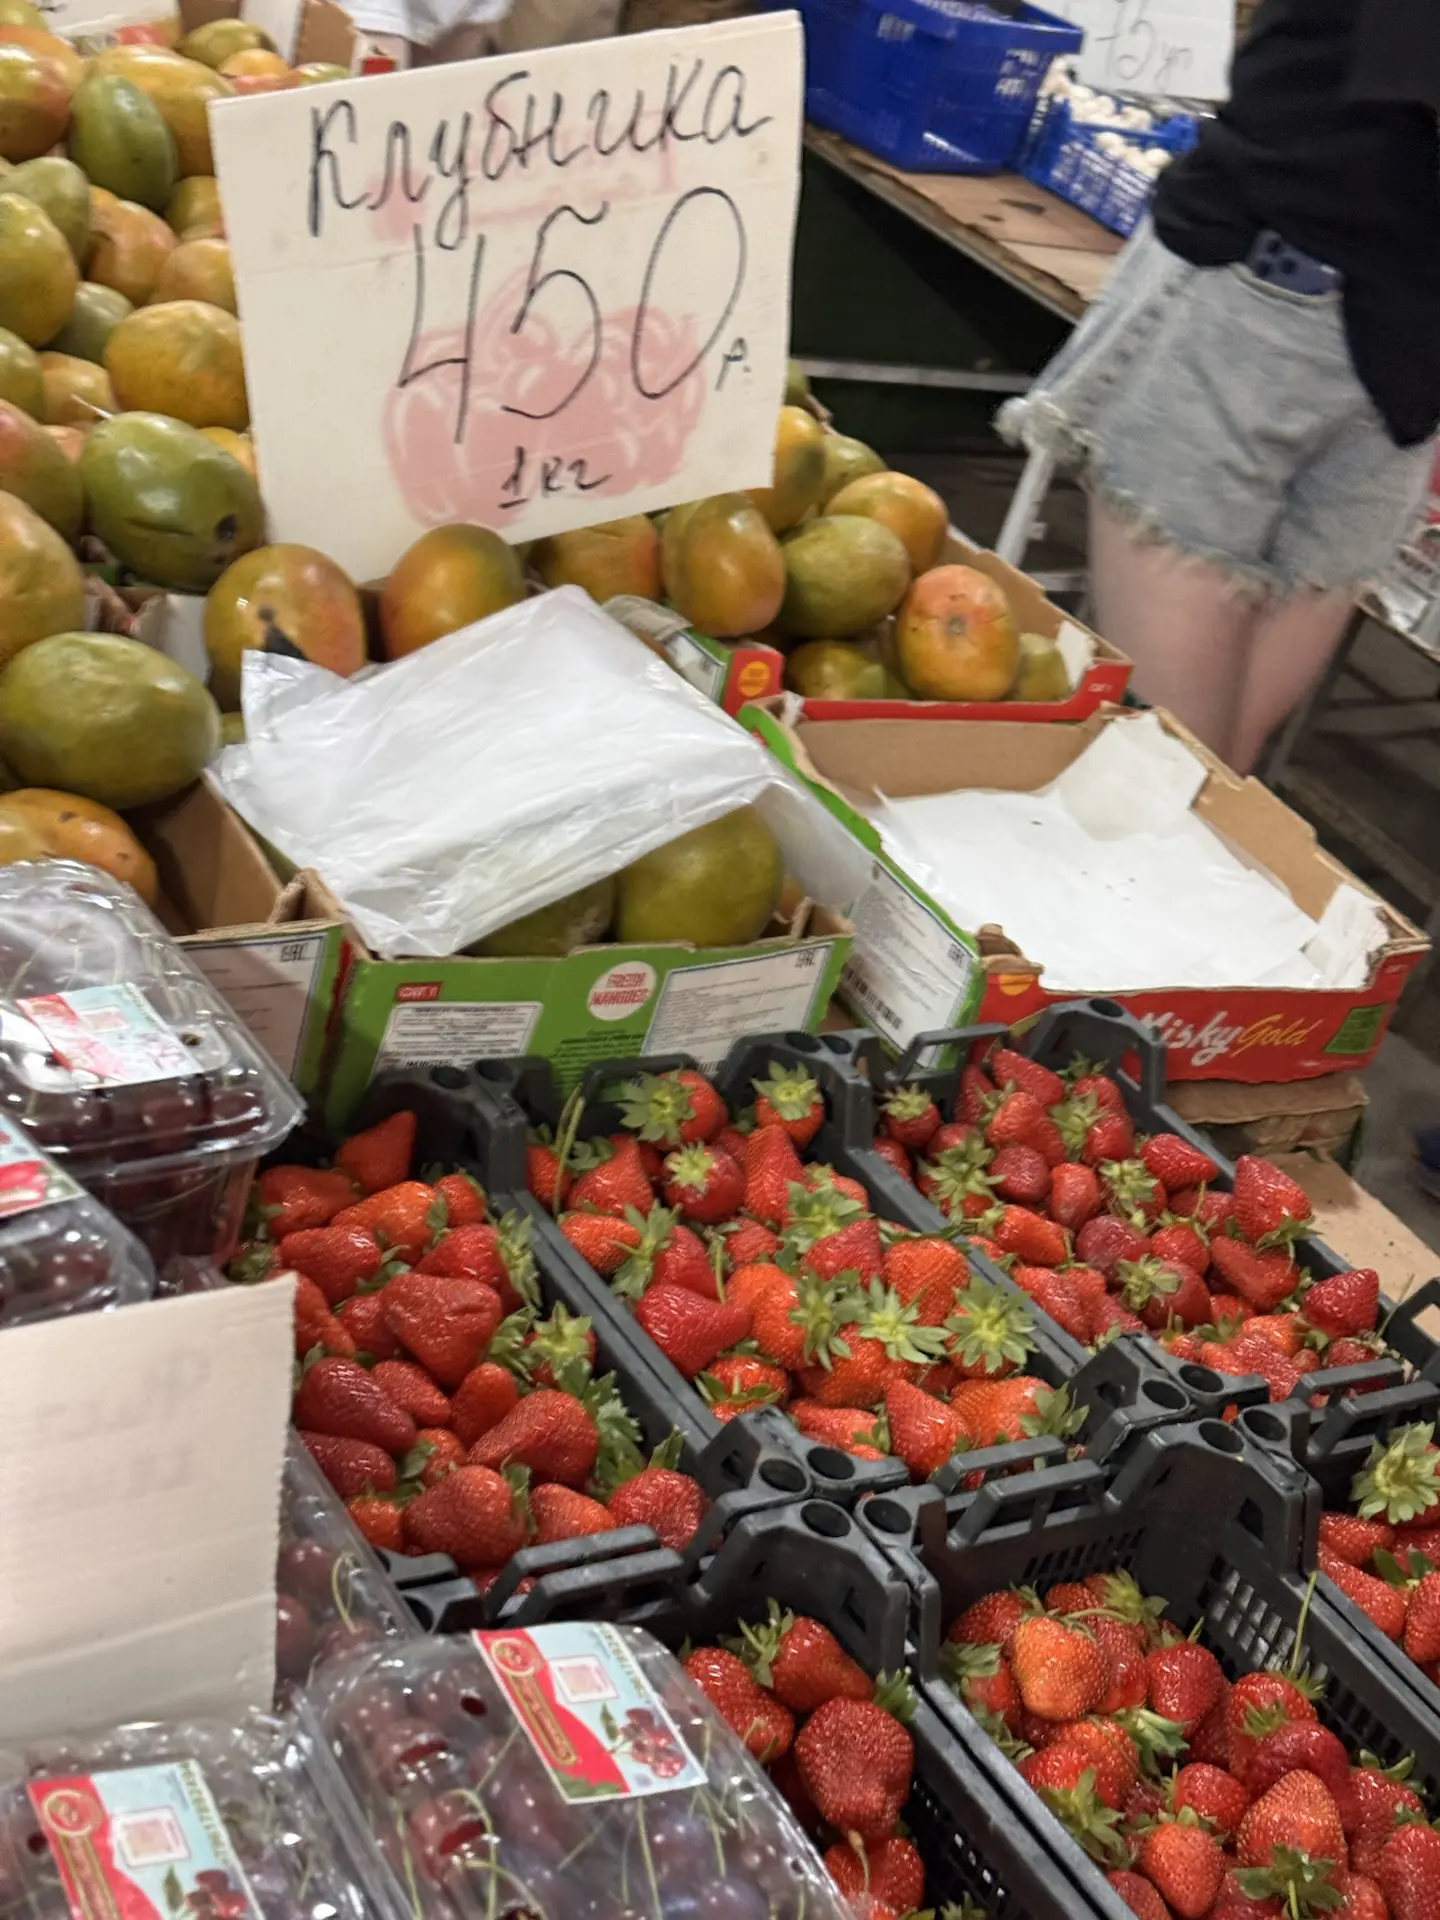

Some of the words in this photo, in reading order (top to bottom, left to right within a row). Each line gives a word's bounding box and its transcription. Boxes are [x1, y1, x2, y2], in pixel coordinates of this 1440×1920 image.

[308, 58, 773, 250] Клубника
[398, 186, 747, 443] 450
[1229, 1014, 1324, 1058] Gold
